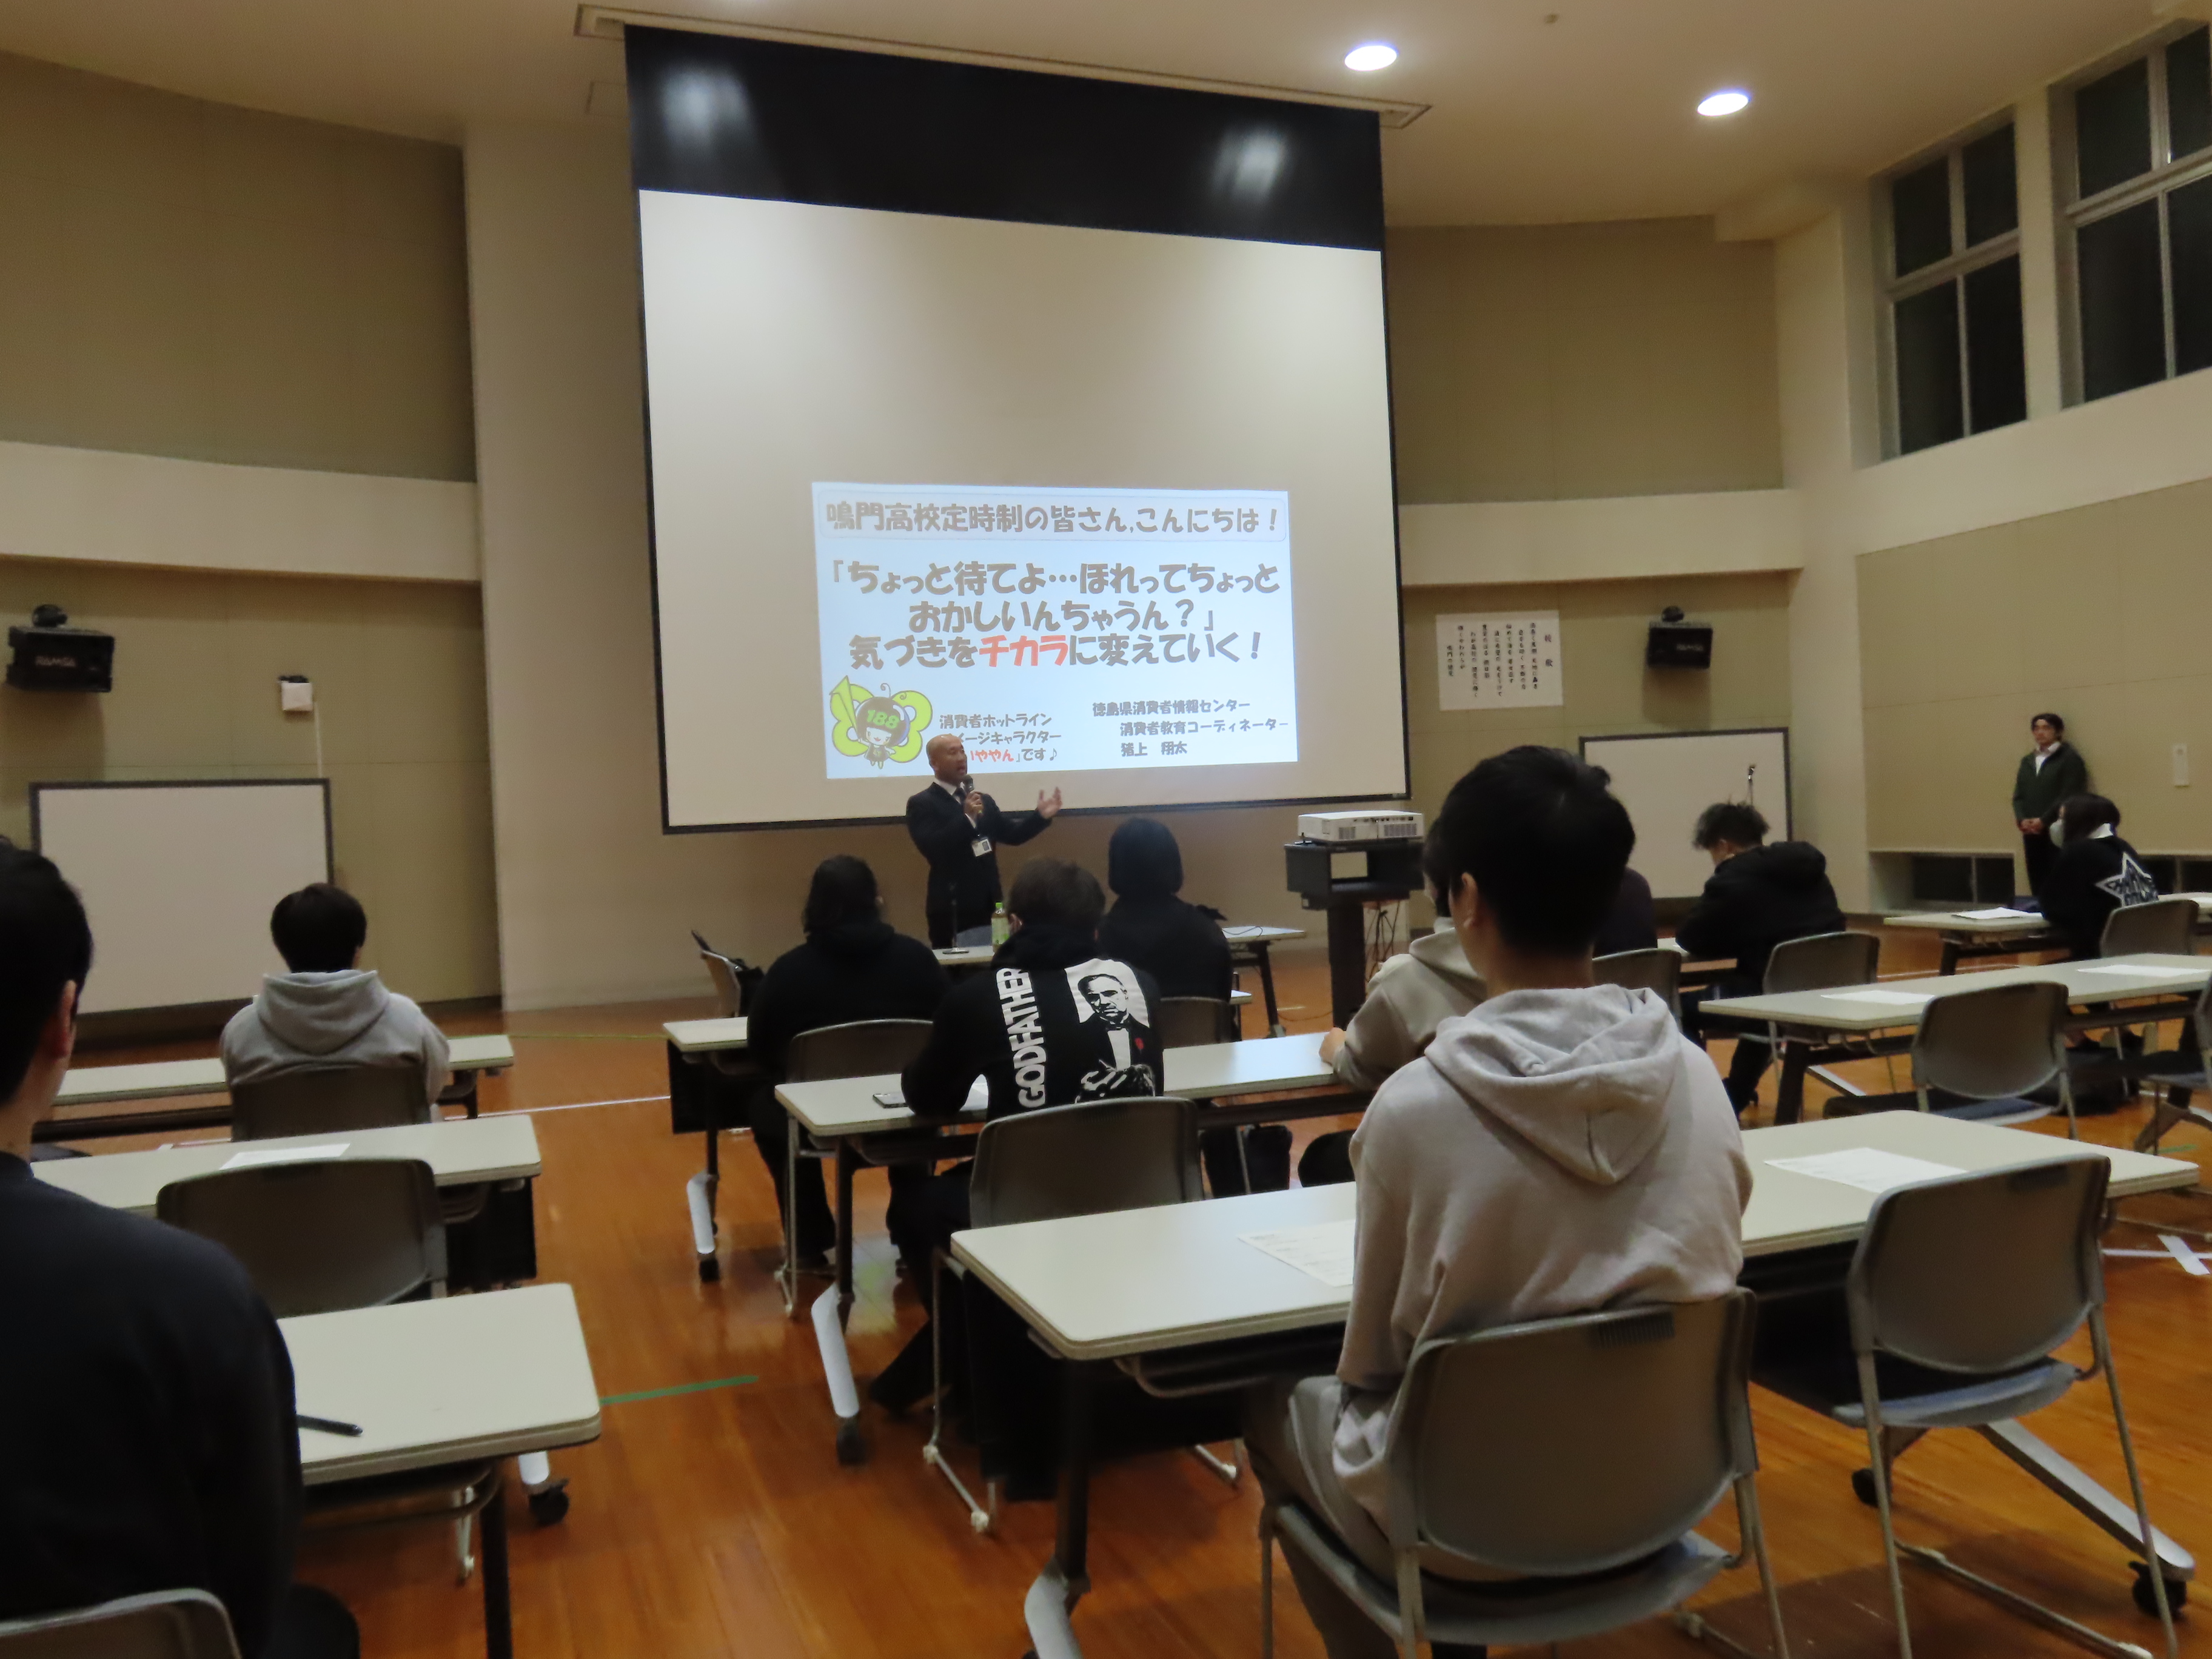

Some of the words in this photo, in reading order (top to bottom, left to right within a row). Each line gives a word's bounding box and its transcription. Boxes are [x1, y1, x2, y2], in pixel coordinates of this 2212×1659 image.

[1092, 699, 1250, 717] 徳島県消費者情報センター
[867, 709, 900, 729] 188
[939, 713, 1052, 729] 消費者ホットライン
[1120, 718, 1289, 736] 消費者教育コーディネーター
[957, 730, 1062, 745] メージキャラクター
[996, 968, 1047, 1108] GODFATHER
